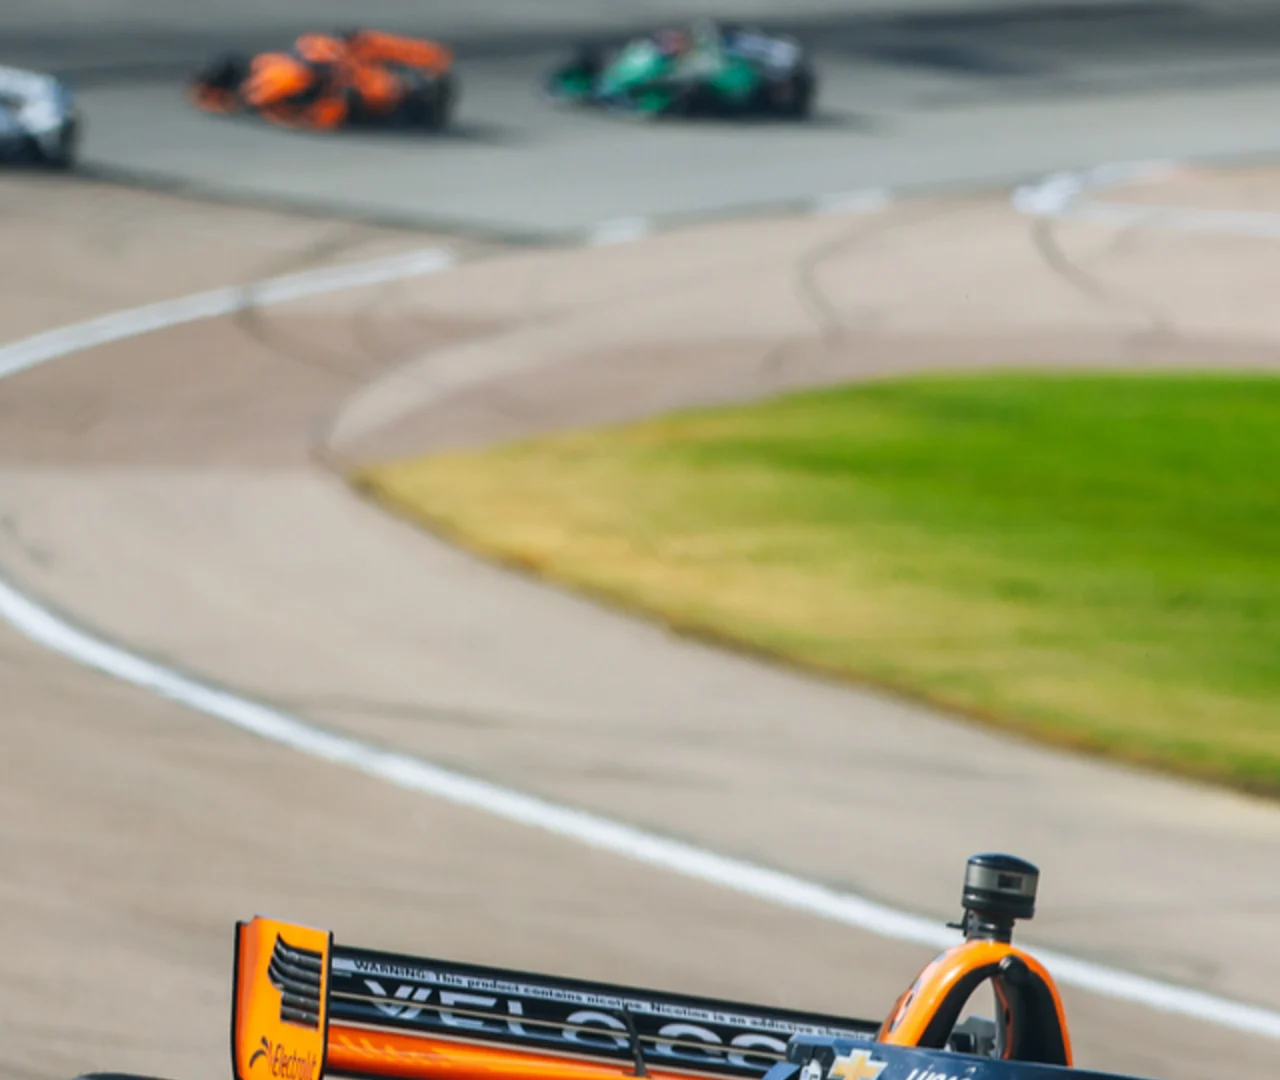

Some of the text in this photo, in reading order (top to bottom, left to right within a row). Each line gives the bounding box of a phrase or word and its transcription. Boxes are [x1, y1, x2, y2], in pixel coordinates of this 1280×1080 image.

[363, 978, 631, 1052] VELO
[435, 971, 463, 987] This
[467, 976, 520, 995] product
[523, 983, 583, 1003] contains
[651, 999, 709, 1020] Nicotine
[713, 1010, 725, 1022] is
[729, 1013, 747, 1026] an
[750, 1015, 814, 1035] addictive
